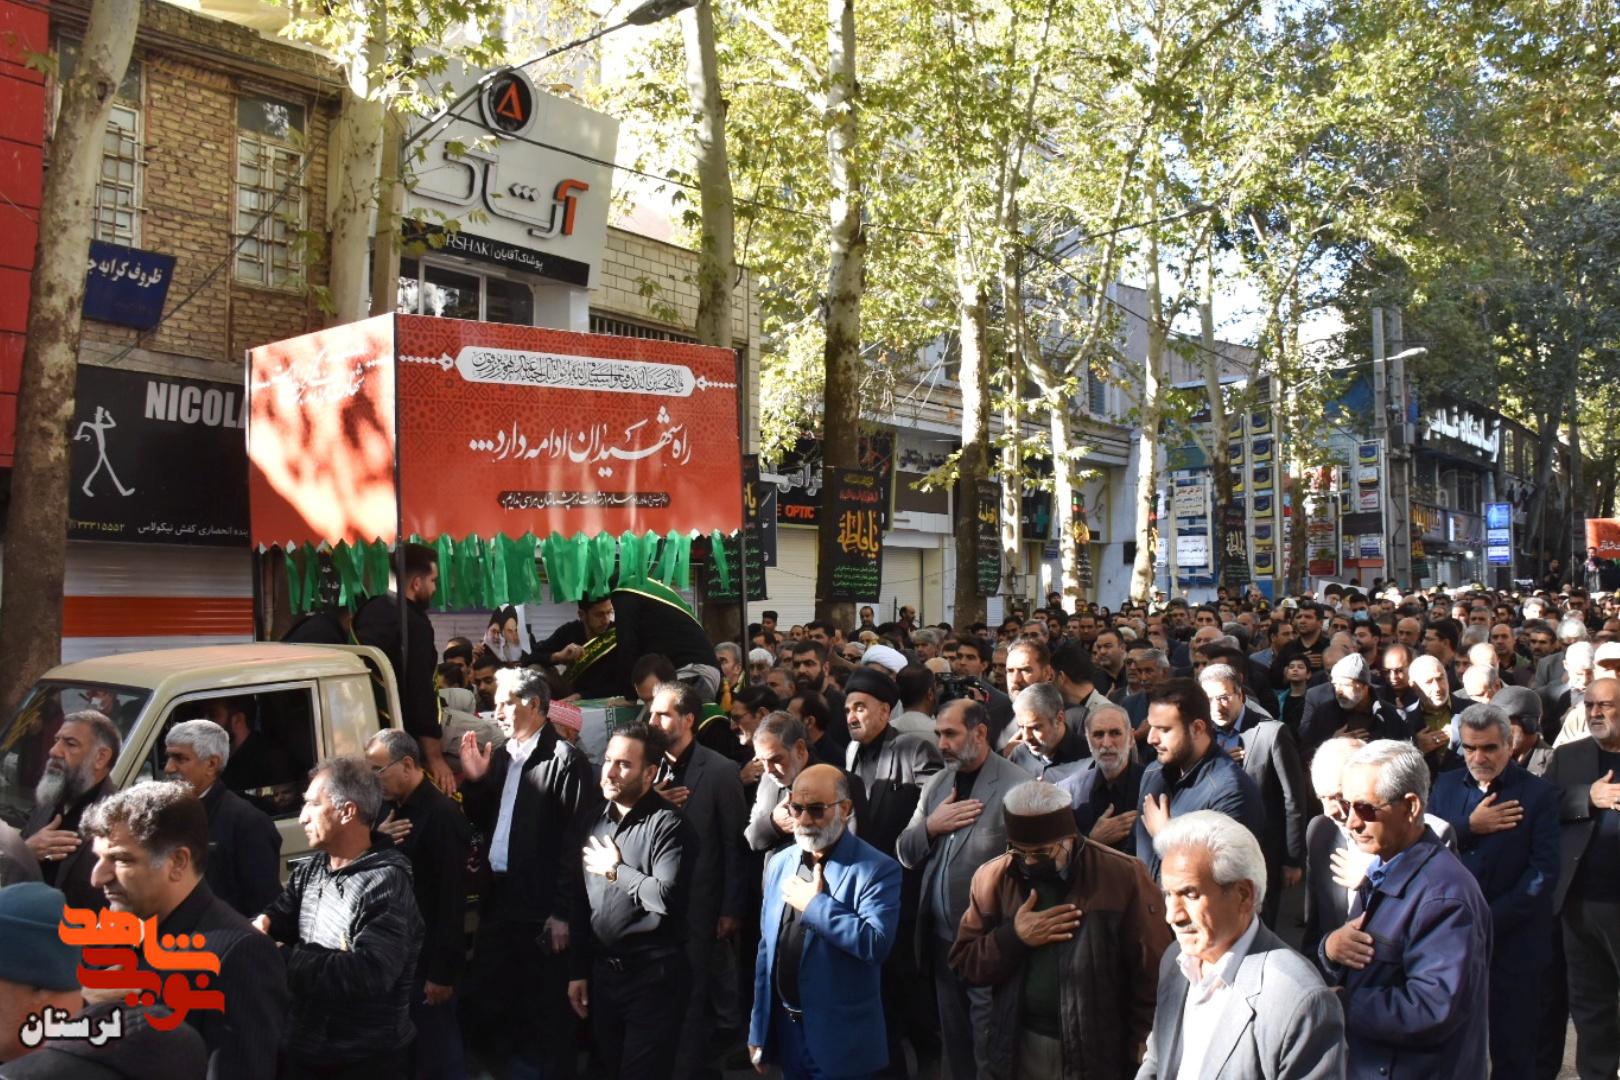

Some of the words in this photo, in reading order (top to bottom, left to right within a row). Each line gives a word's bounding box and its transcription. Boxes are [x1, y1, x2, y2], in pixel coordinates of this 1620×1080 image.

[402, 141, 590, 240] آرشاک
[446, 233, 489, 256] RSHAK
[494, 248, 520, 262] آقایان
[98, 258, 130, 282] کرایه
[128, 261, 162, 288] ظروف
[519, 253, 544, 273] پوشاک
[525, 427, 568, 460] ادامه
[568, 405, 684, 478] شهیدان
[671, 427, 692, 467] راه
[784, 504, 815, 519] OPTIC
[137, 521, 174, 535] نیکولاس
[175, 524, 197, 536] کفش
